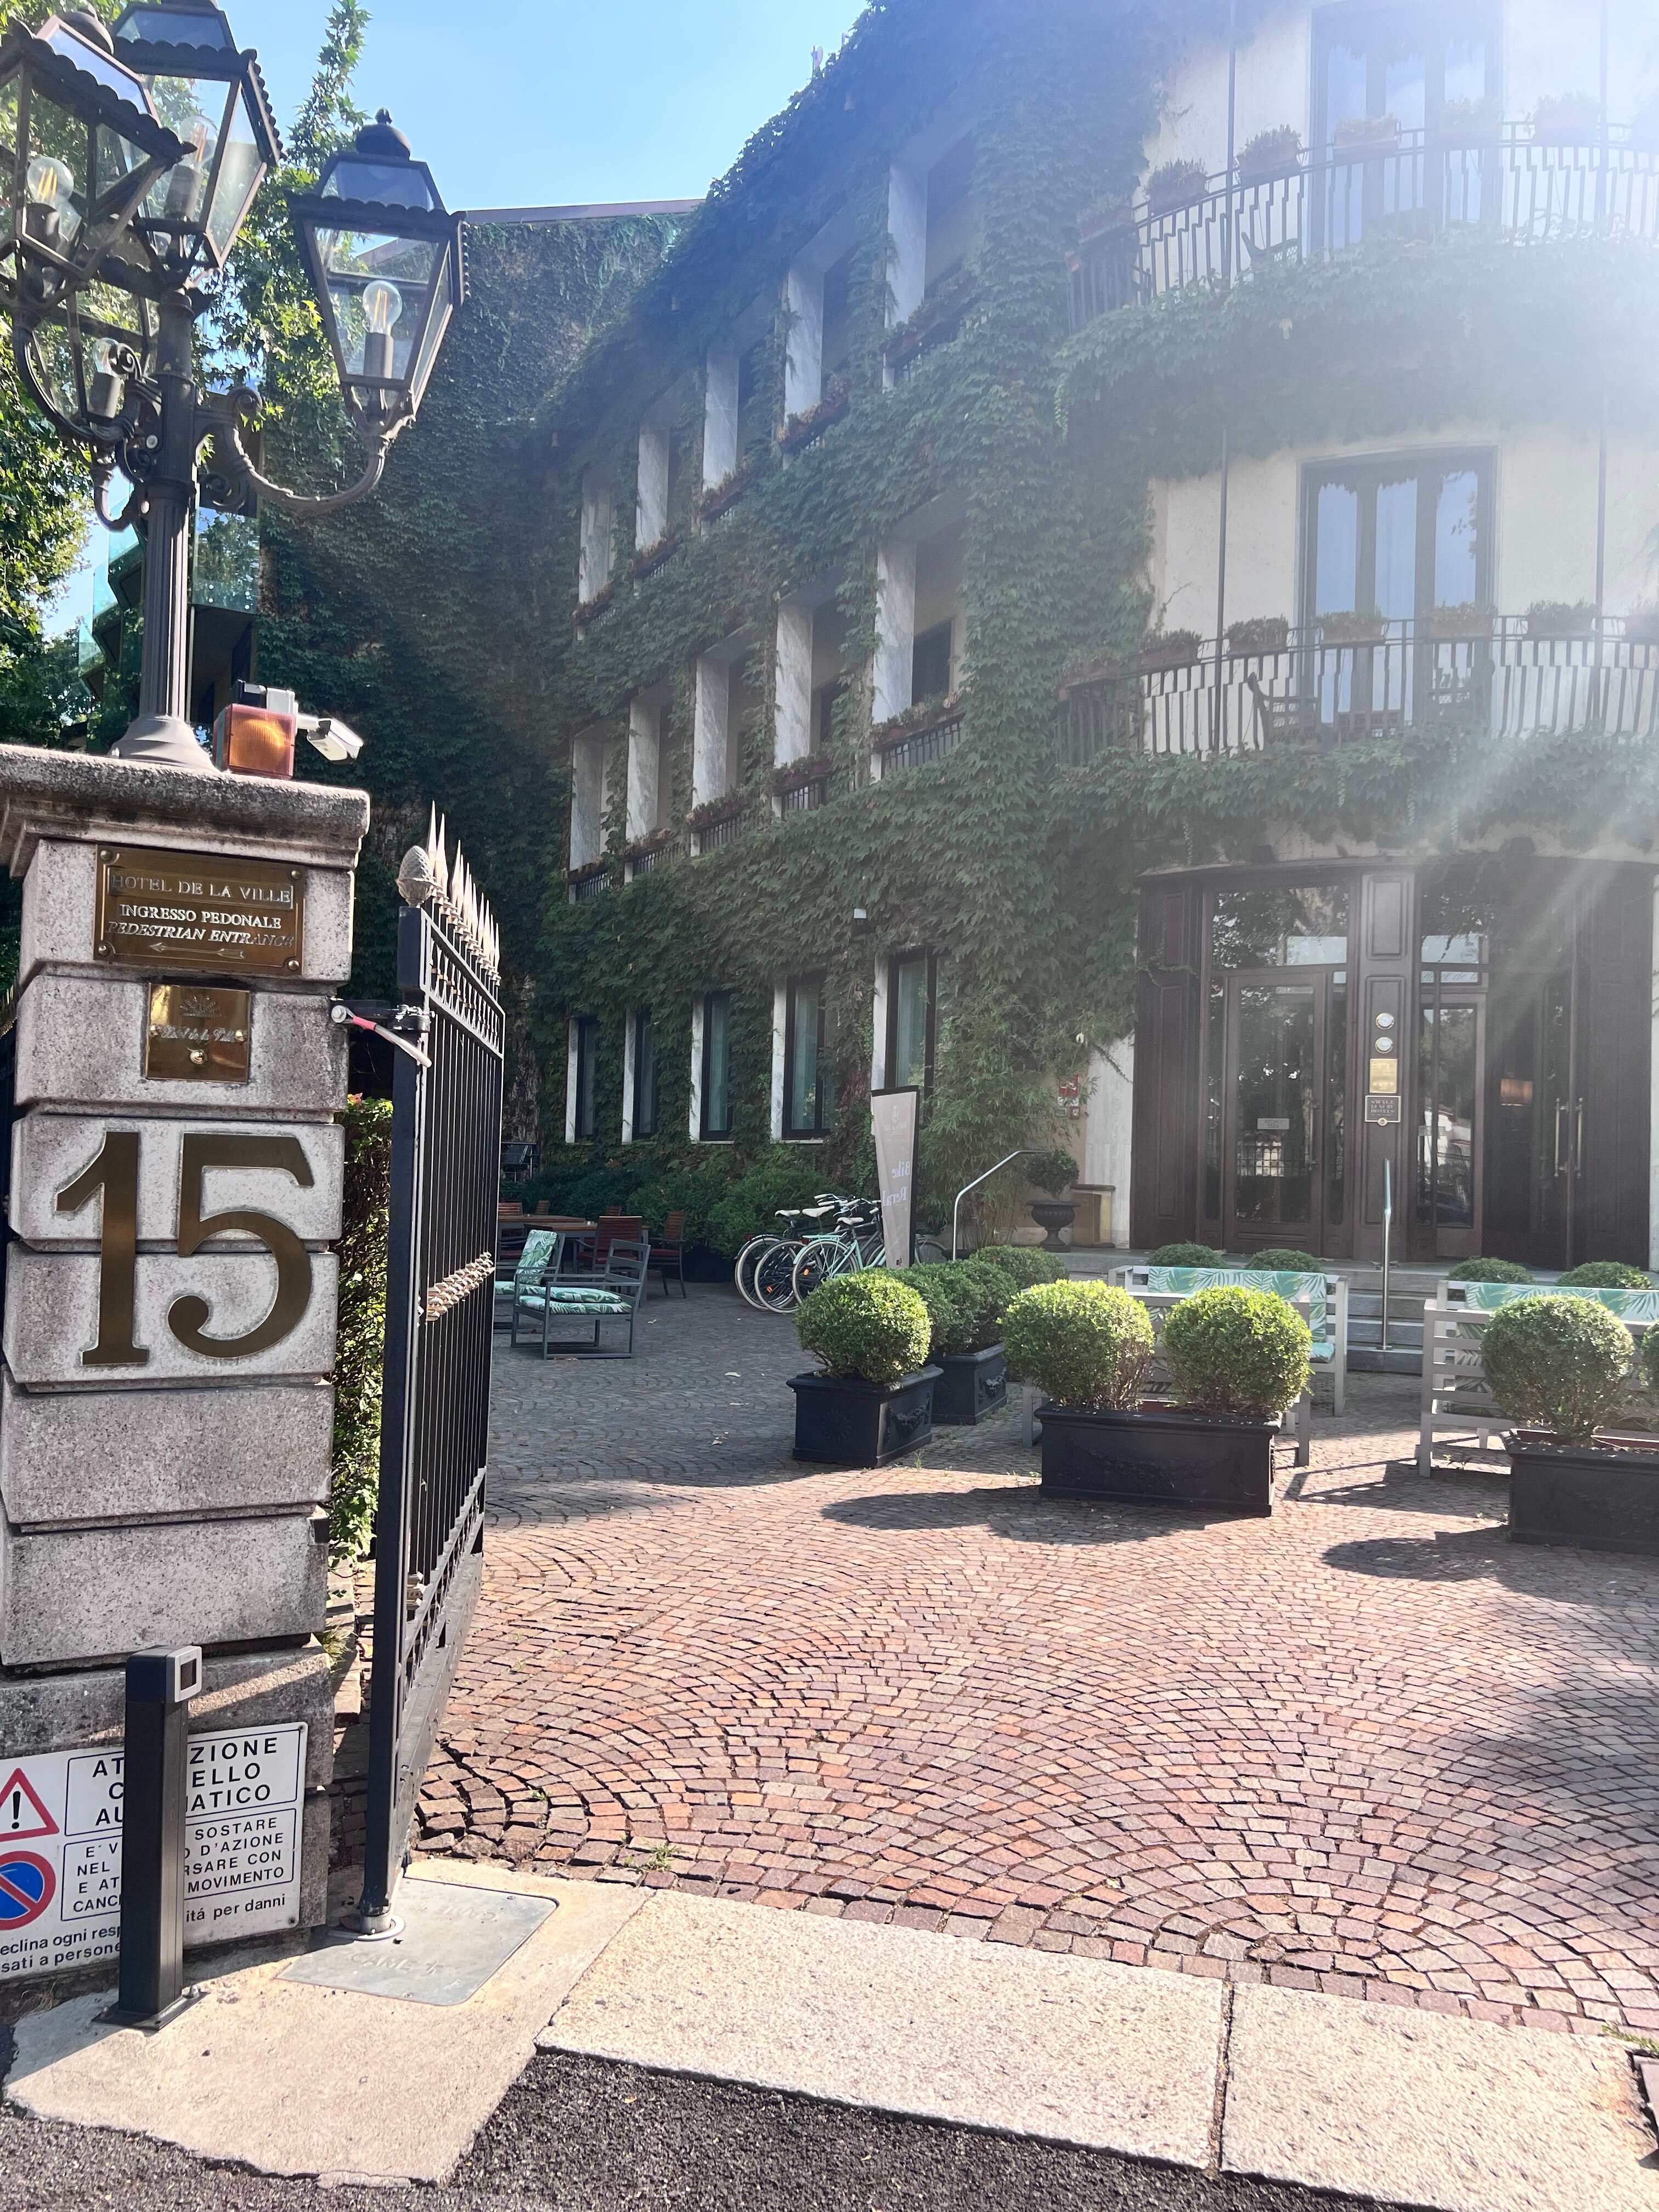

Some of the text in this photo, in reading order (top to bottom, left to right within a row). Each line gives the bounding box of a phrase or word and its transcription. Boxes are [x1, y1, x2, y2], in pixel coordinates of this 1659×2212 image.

[111, 874, 291, 903] HOTEL DE LA VILLE
[119, 904, 282, 930] INGRESSO PEDONALE
[105, 921, 295, 947] PEDESTRIAN ENTRANCE
[56, 1131, 314, 1365] 15
[194, 1817, 277, 1841] SOSTARE
[77, 1861, 110, 1877] NEL
[200, 1832, 284, 1857] D'AZIONE
[78, 1882, 88, 1894] E
[247, 1849, 281, 1866] CON
[188, 1866, 284, 1894] MOVIMENTO
[0, 1938, 48, 1956] eclina
[52, 1928, 87, 1947] ogni
[213, 1904, 240, 1921] per
[244, 1893, 286, 1912] danni
[0, 1954, 33, 1973] sati
[39, 1955, 49, 1966] a
[351, 1953, 418, 1972] CAME
